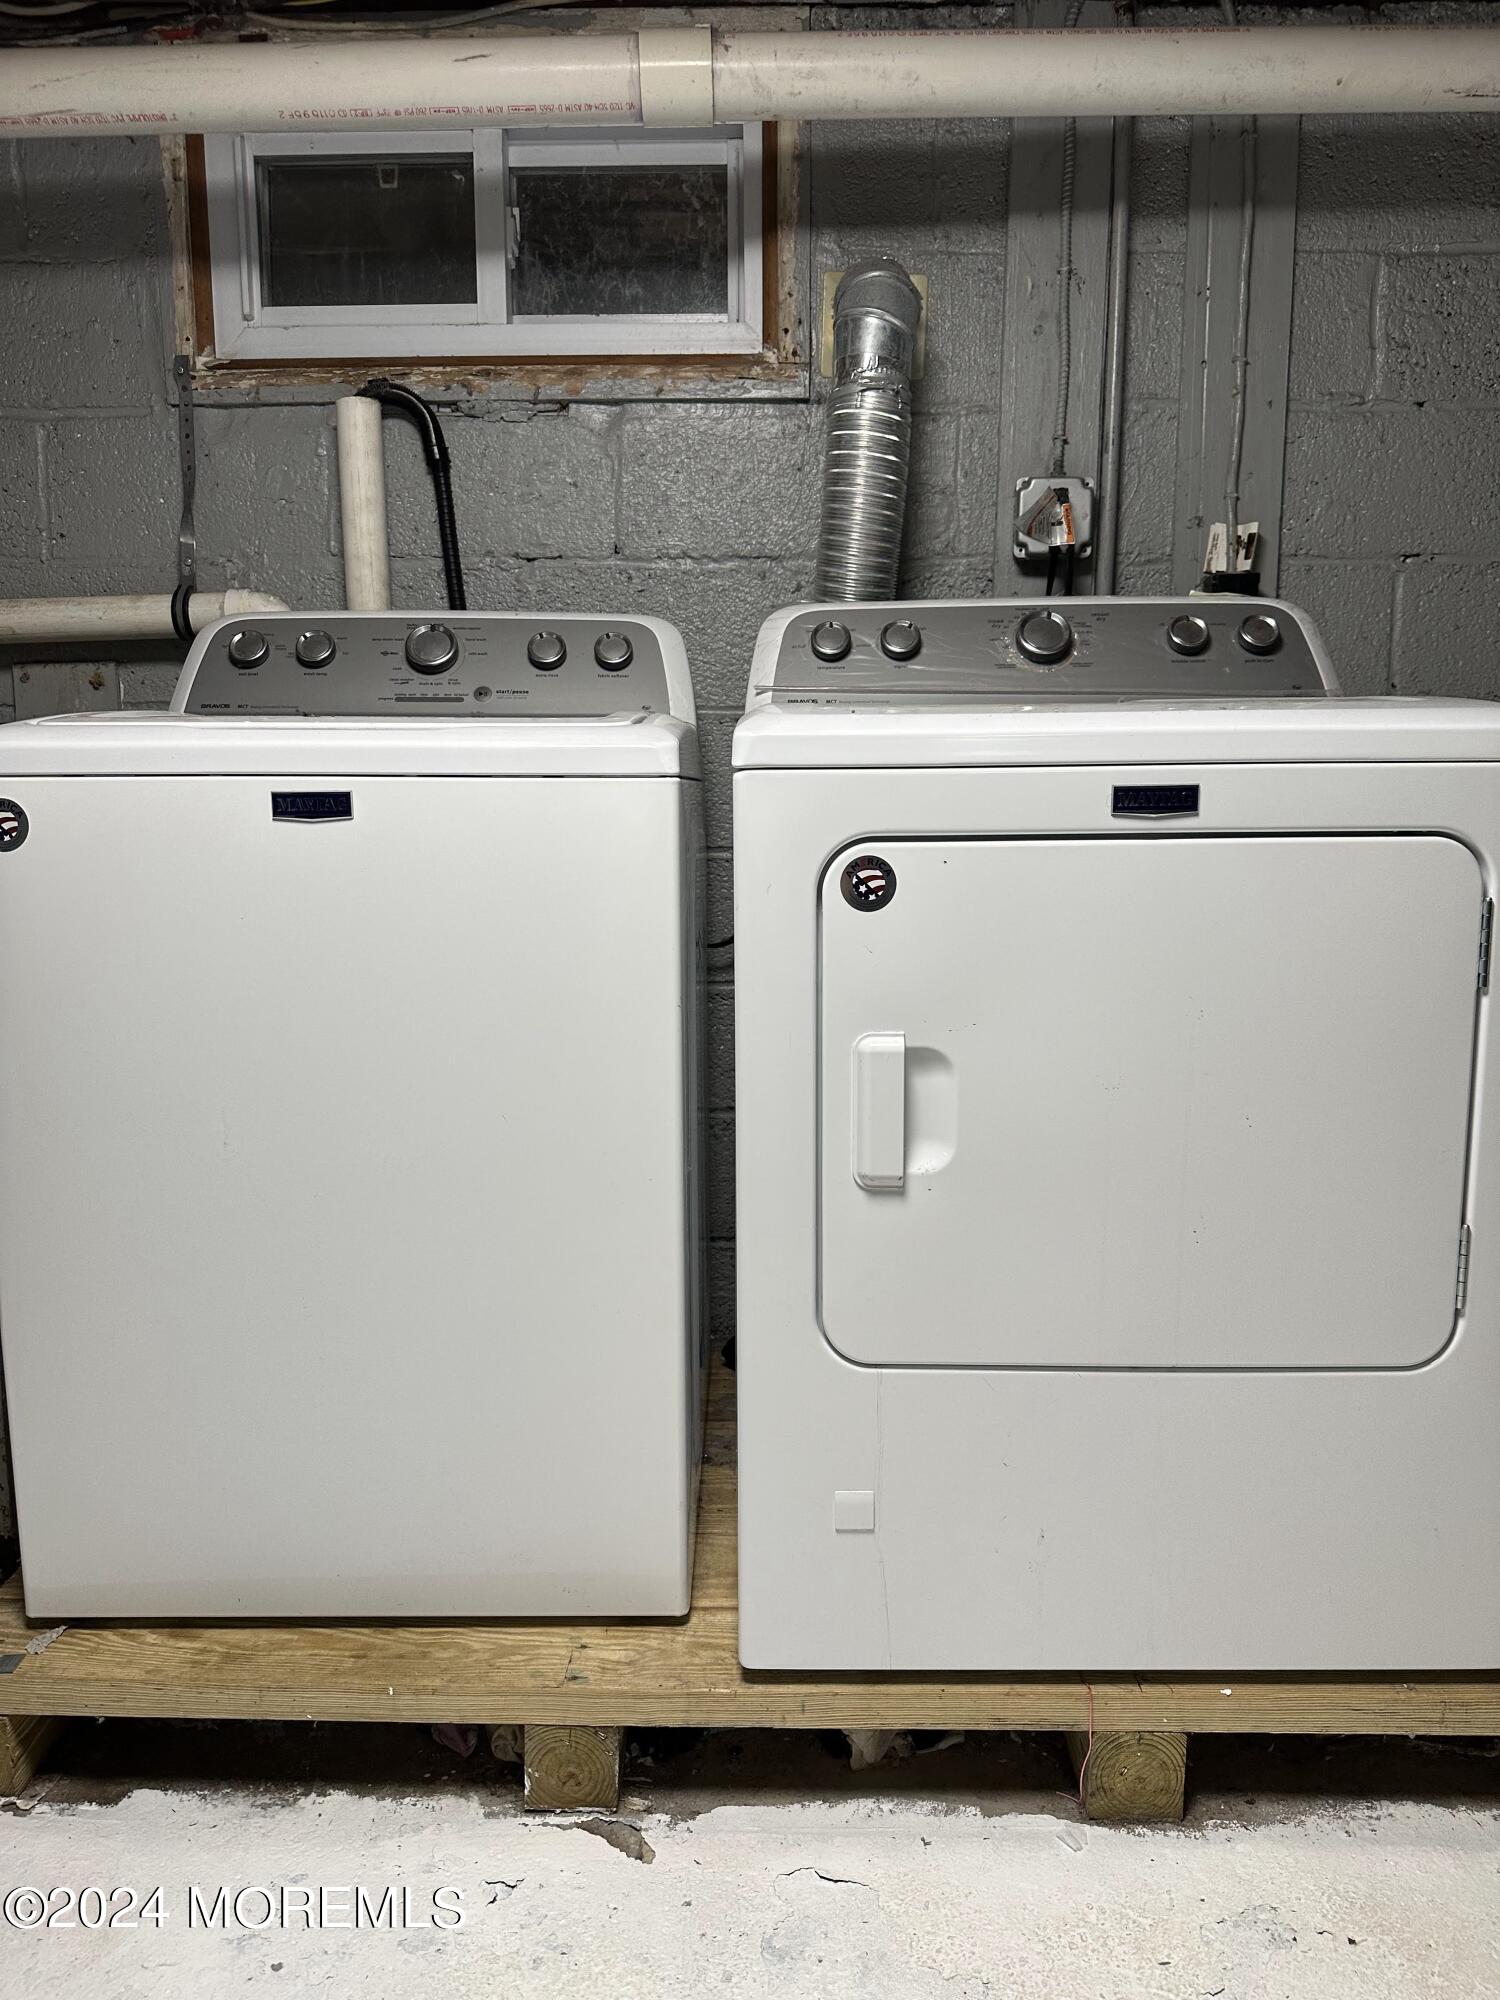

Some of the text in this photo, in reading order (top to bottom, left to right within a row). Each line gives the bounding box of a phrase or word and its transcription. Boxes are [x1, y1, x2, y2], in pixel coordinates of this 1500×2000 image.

[486, 105, 504, 115] ASTM
[564, 104, 582, 113] ASTM
[0, 800, 23, 819] RICA
[846, 858, 892, 879] AMERICA
